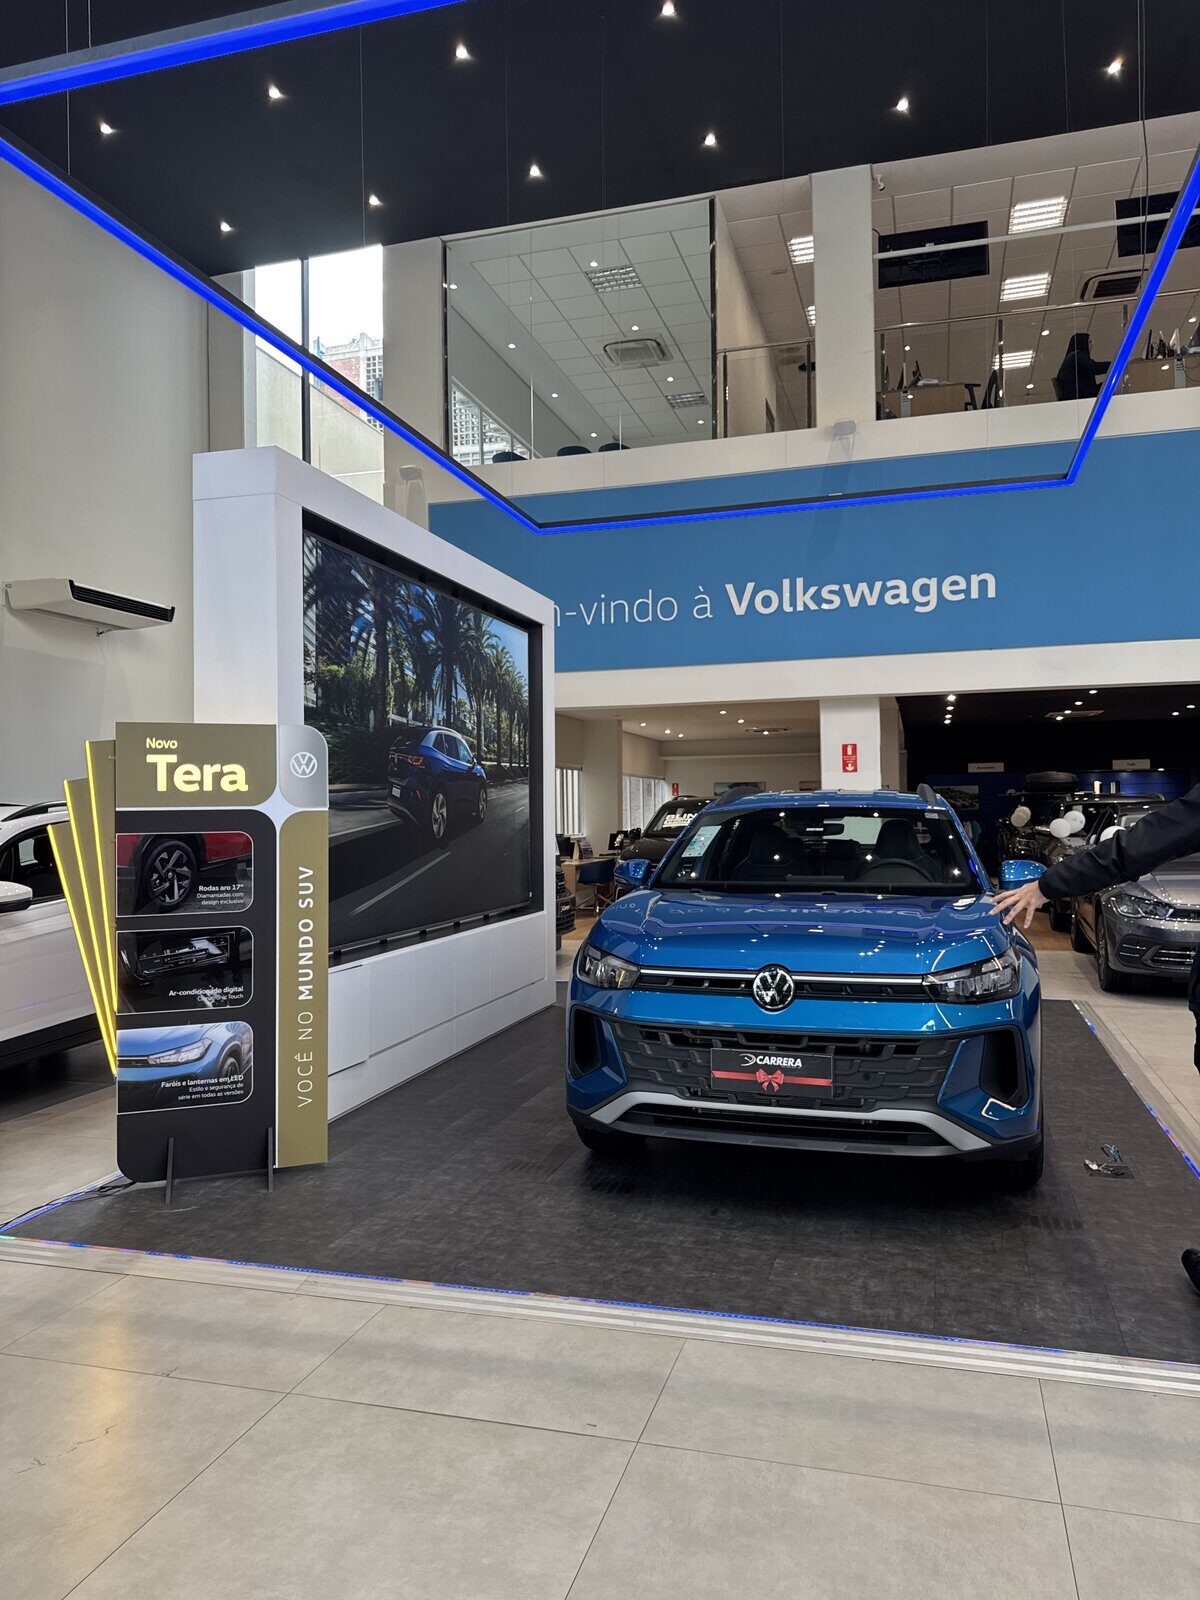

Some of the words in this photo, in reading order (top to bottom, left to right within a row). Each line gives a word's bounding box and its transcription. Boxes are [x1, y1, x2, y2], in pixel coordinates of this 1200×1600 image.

[692, 585, 713, 619] à
[724, 572, 996, 616] Volkswagen
[145, 737, 178, 749] Novo
[145, 754, 249, 793] Tera
[298, 866, 314, 909] SUV
[298, 918, 314, 1000] MUNDO
[168, 987, 222, 996] Ar-condicionado
[223, 985, 244, 994] digital
[298, 1011, 314, 1040] NO
[756, 1055, 803, 1068] CARRERA
[161, 1080, 181, 1088] Faróis
[294, 1051, 314, 1108] VOCÊ
